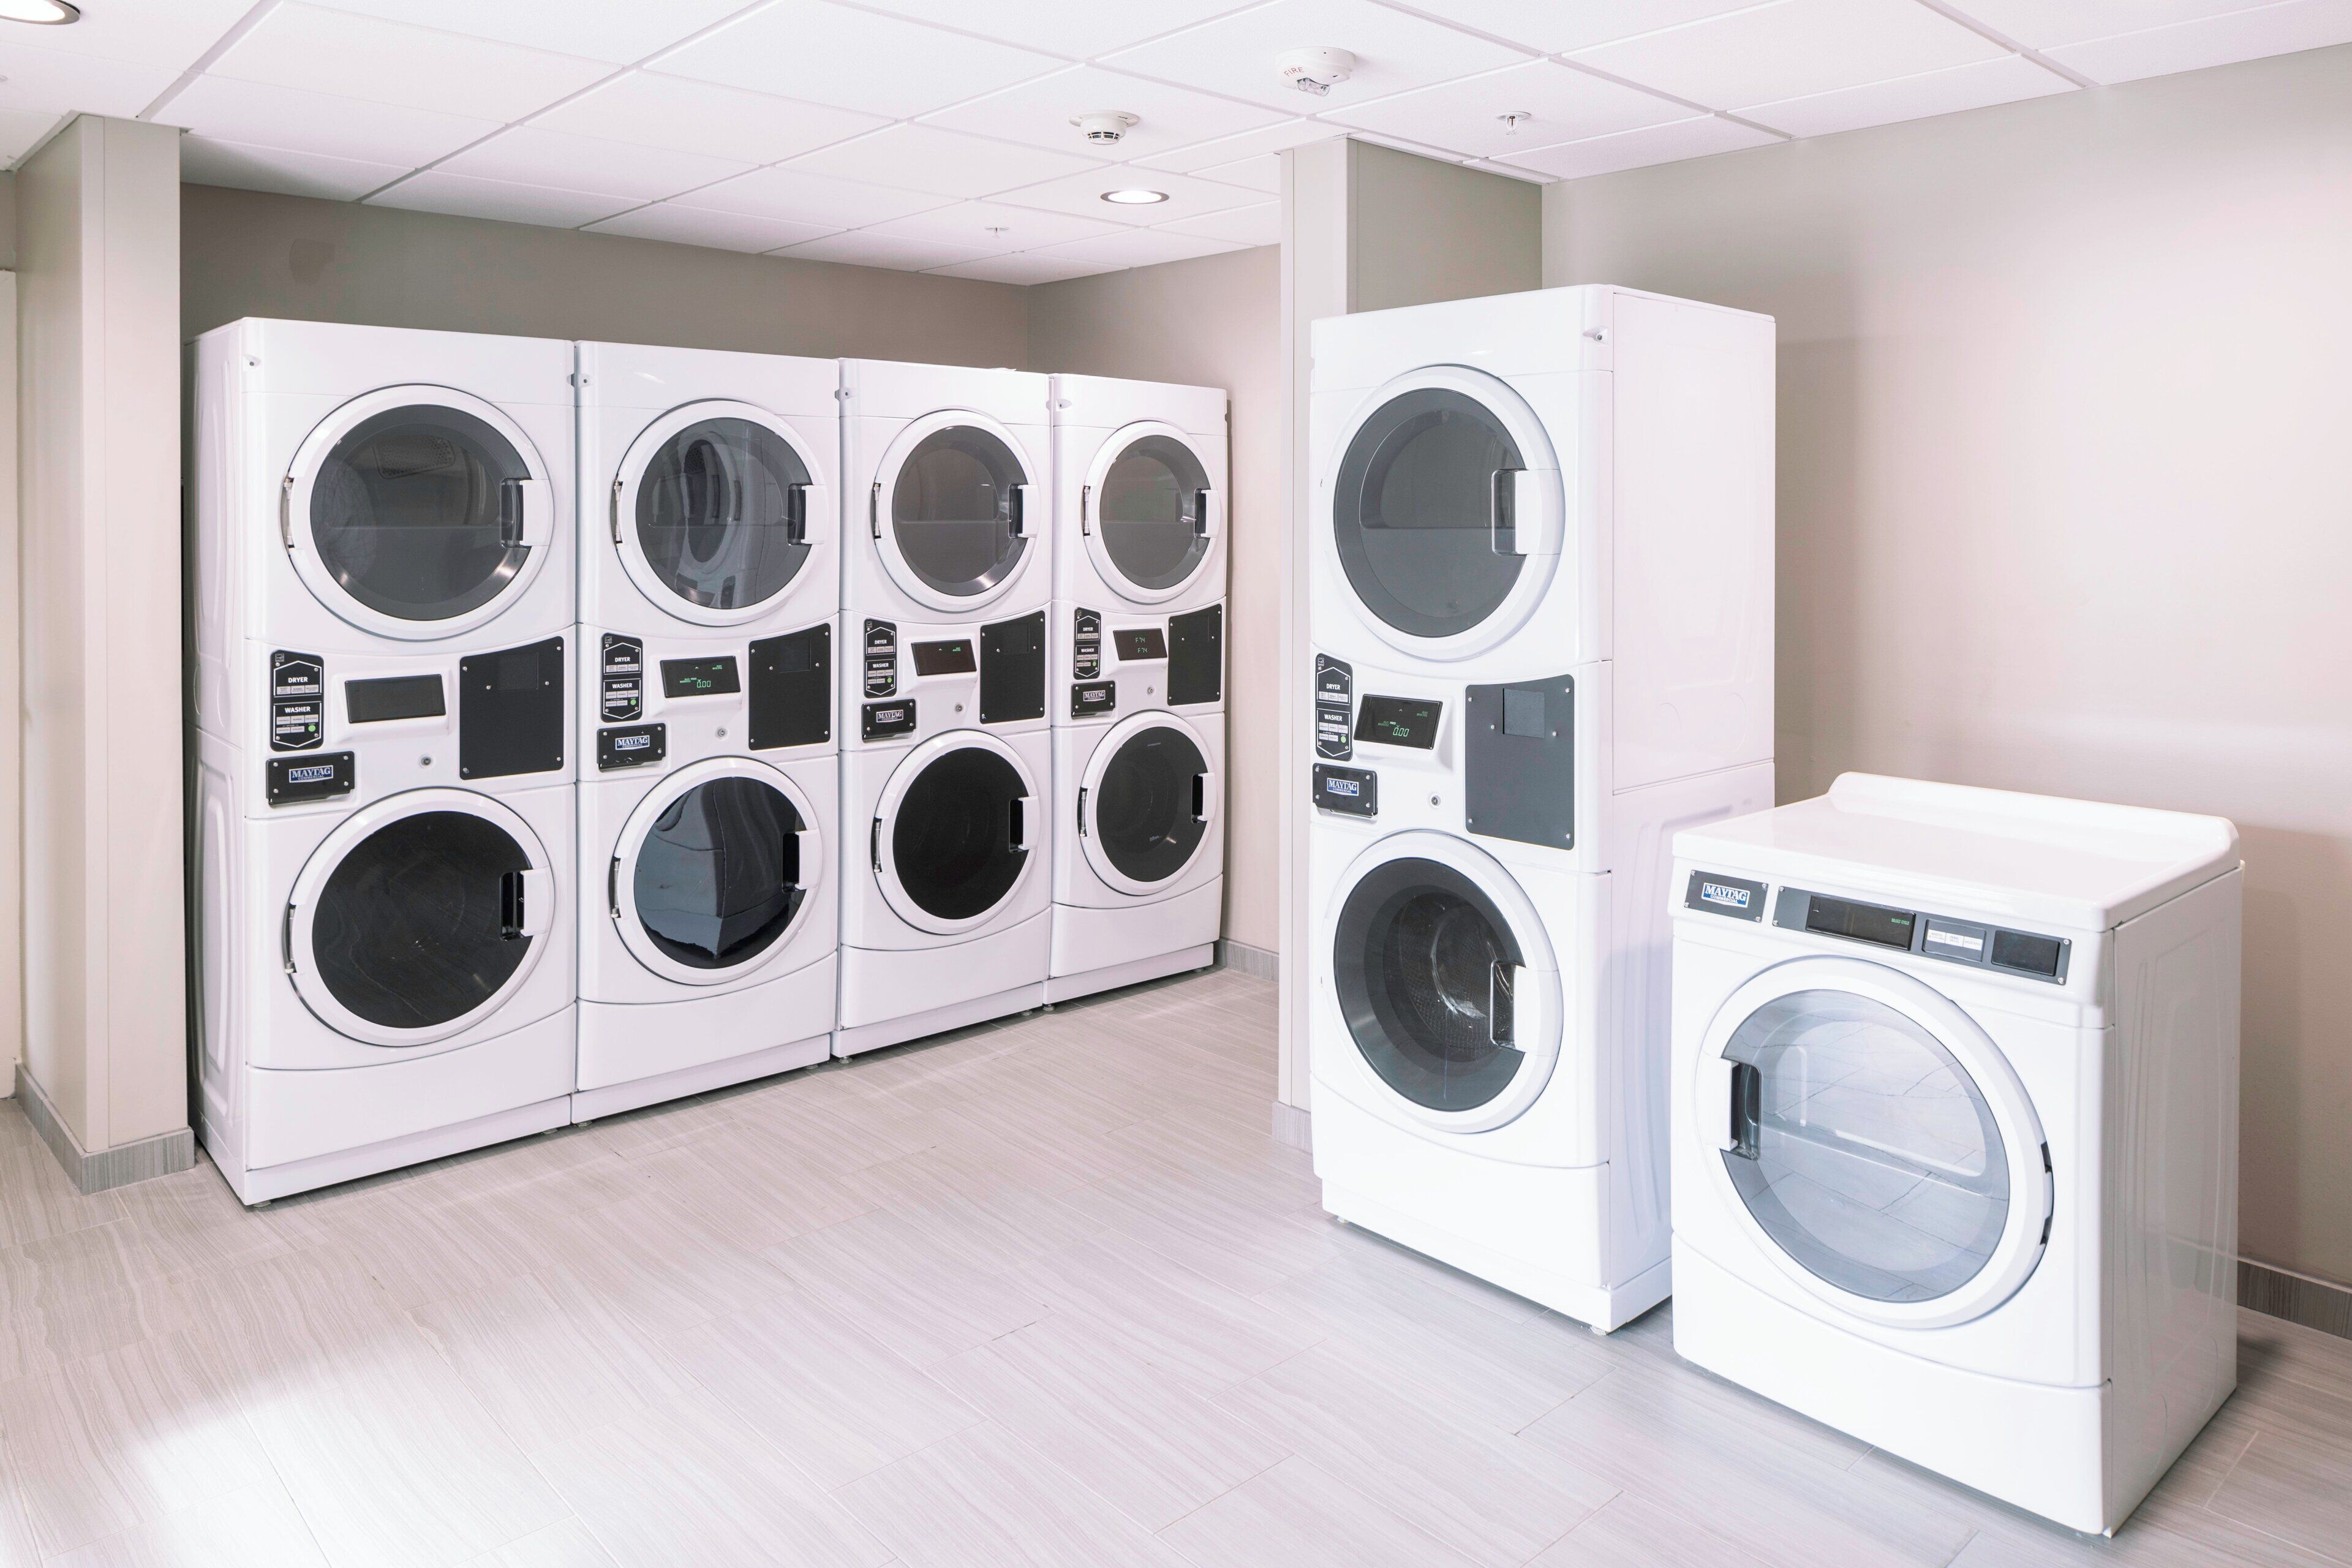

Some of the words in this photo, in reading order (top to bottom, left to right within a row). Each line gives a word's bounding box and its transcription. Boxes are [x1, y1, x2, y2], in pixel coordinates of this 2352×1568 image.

[1284, 67, 1305, 77] FIRE
[1392, 727, 1409, 737] 0.00
[617, 737, 648, 747] MAYTAG
[292, 767, 331, 778] MAYTAG
[1329, 780, 1357, 791] MAYTAG
[1705, 884, 1747, 902] MAYTAG
[1710, 894, 1738, 904] COMMERCIAL
